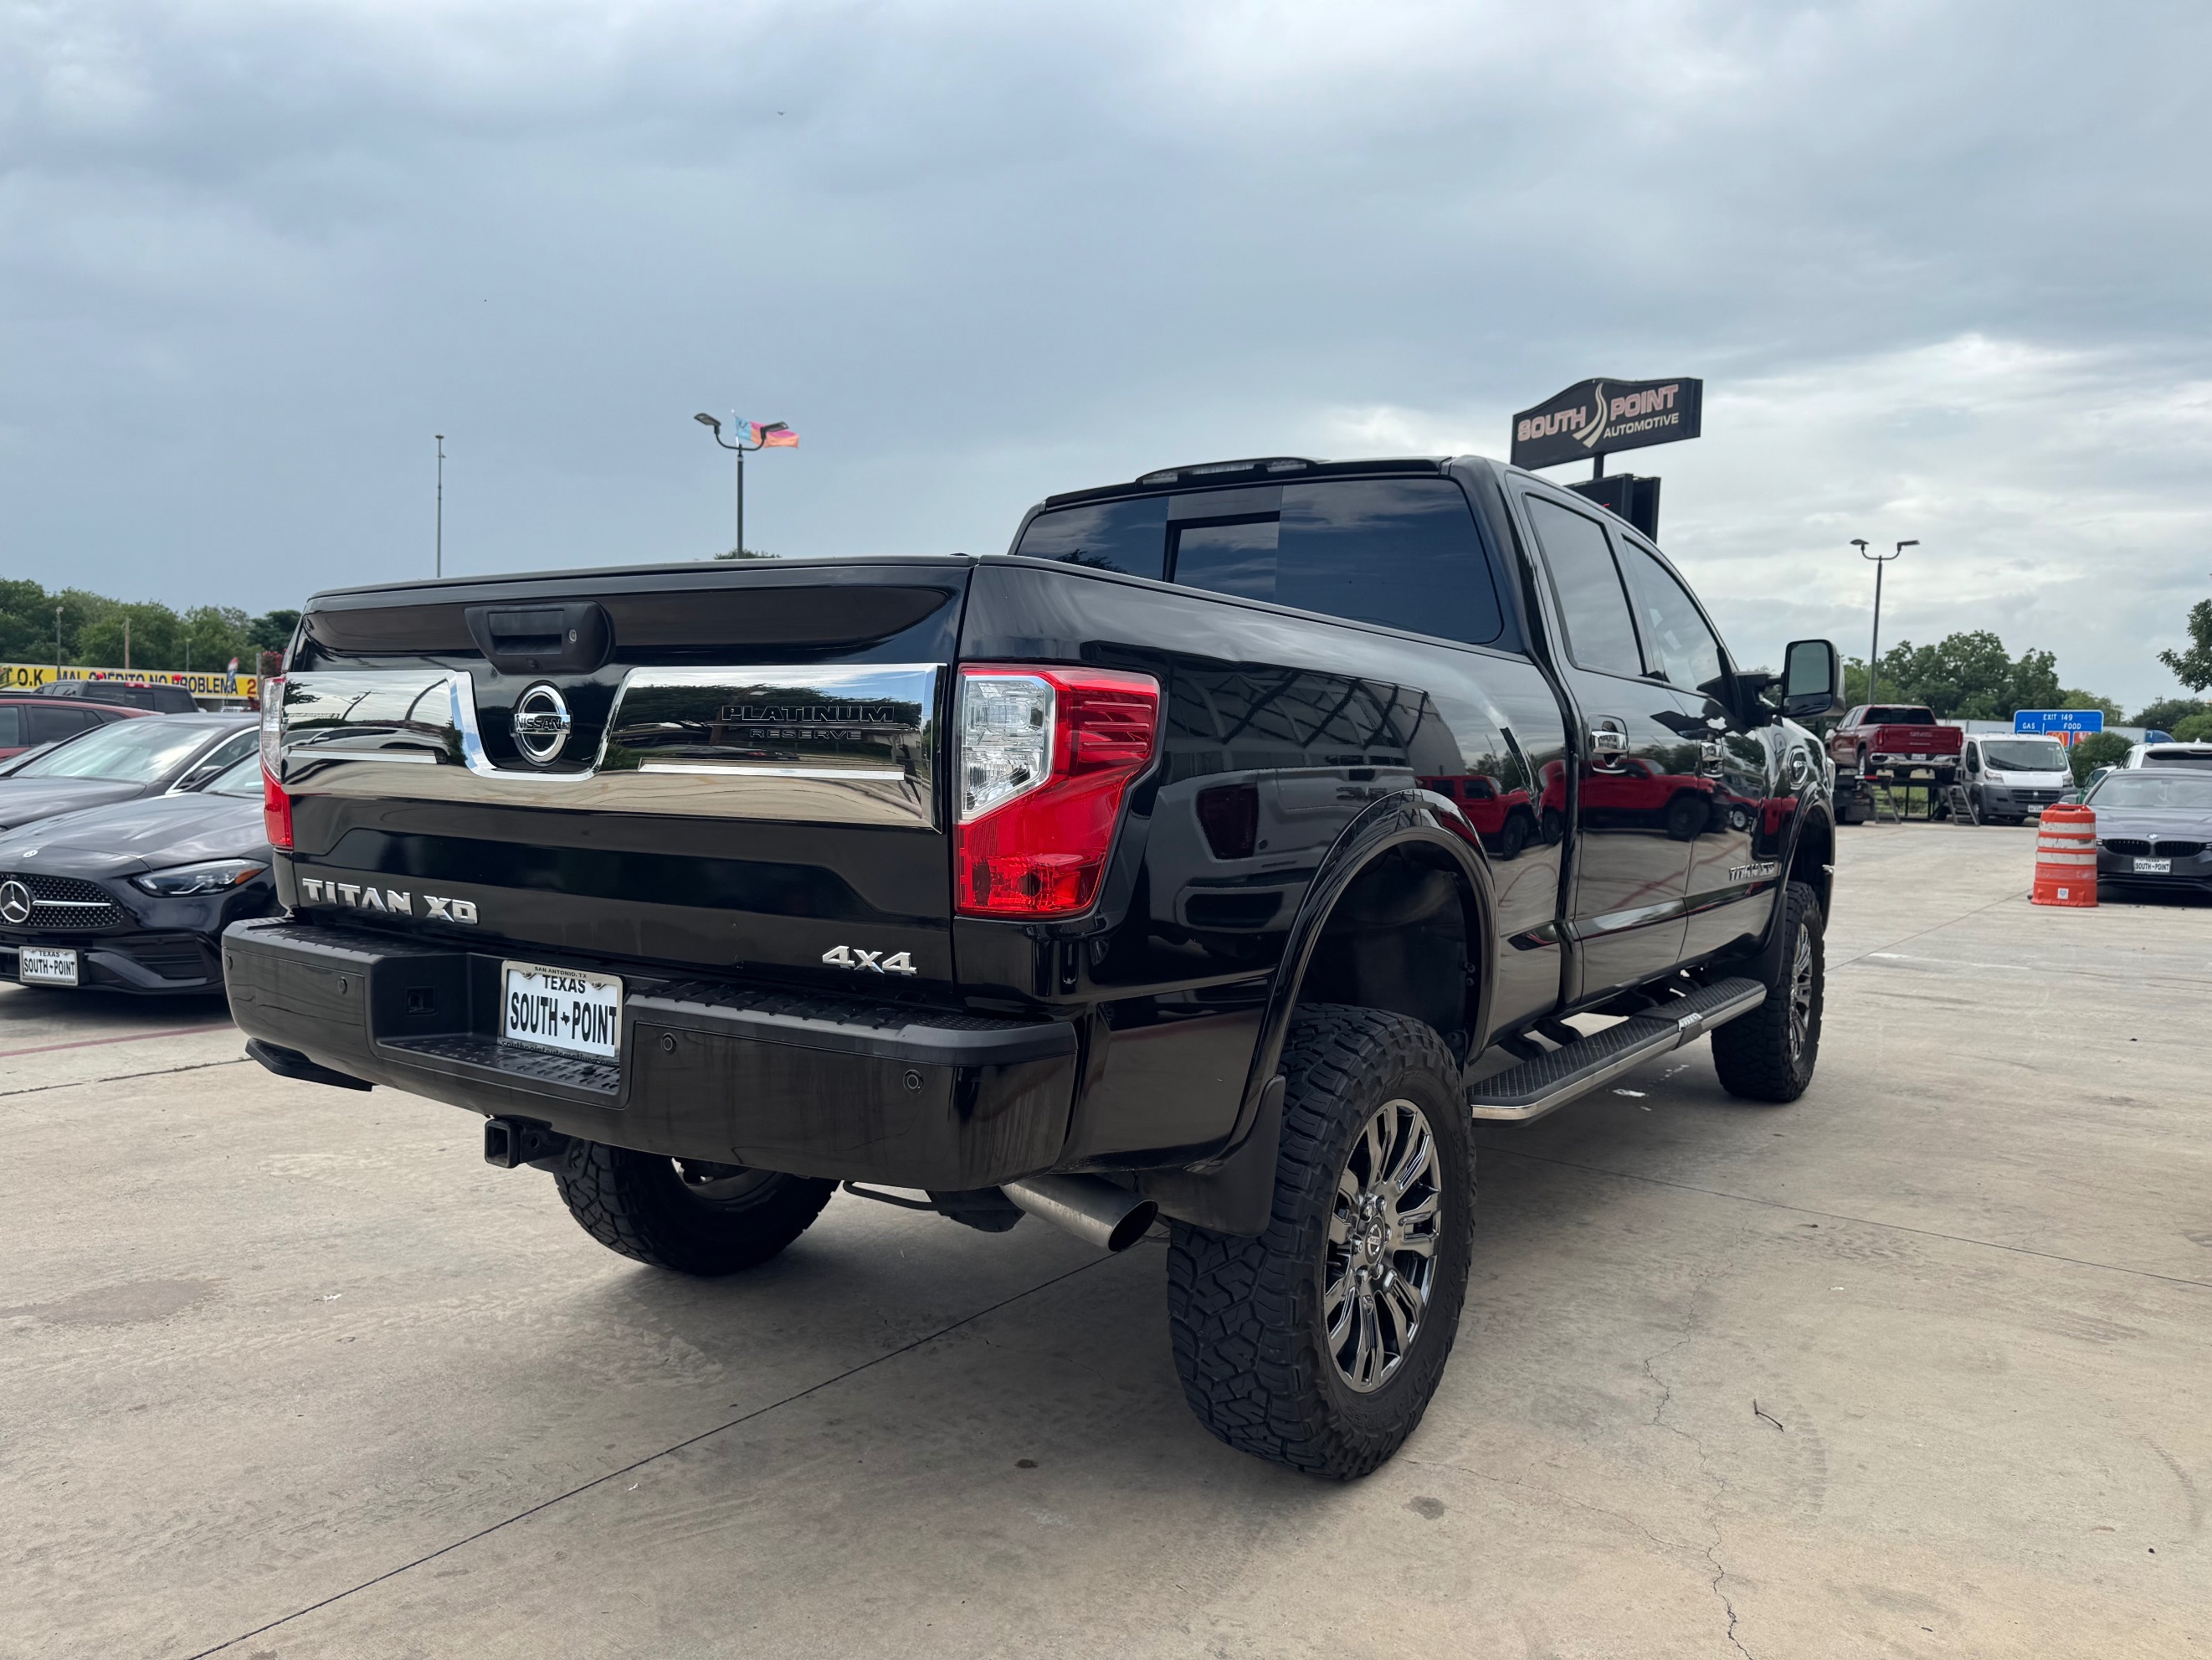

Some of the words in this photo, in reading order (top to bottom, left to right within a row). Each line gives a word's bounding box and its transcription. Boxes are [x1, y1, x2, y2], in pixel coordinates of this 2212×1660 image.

[1517, 406, 1586, 441] SOUTH
[1610, 383, 1679, 421] POINT
[1603, 413, 1680, 439] AUTOMOTIVE
[516, 715, 562, 730] NISSAN
[721, 706, 895, 722] PLATINUM
[750, 729, 861, 740] RESERVE
[302, 878, 413, 917] TITAN
[423, 895, 479, 924] XD
[542, 974, 586, 994] TEXAS
